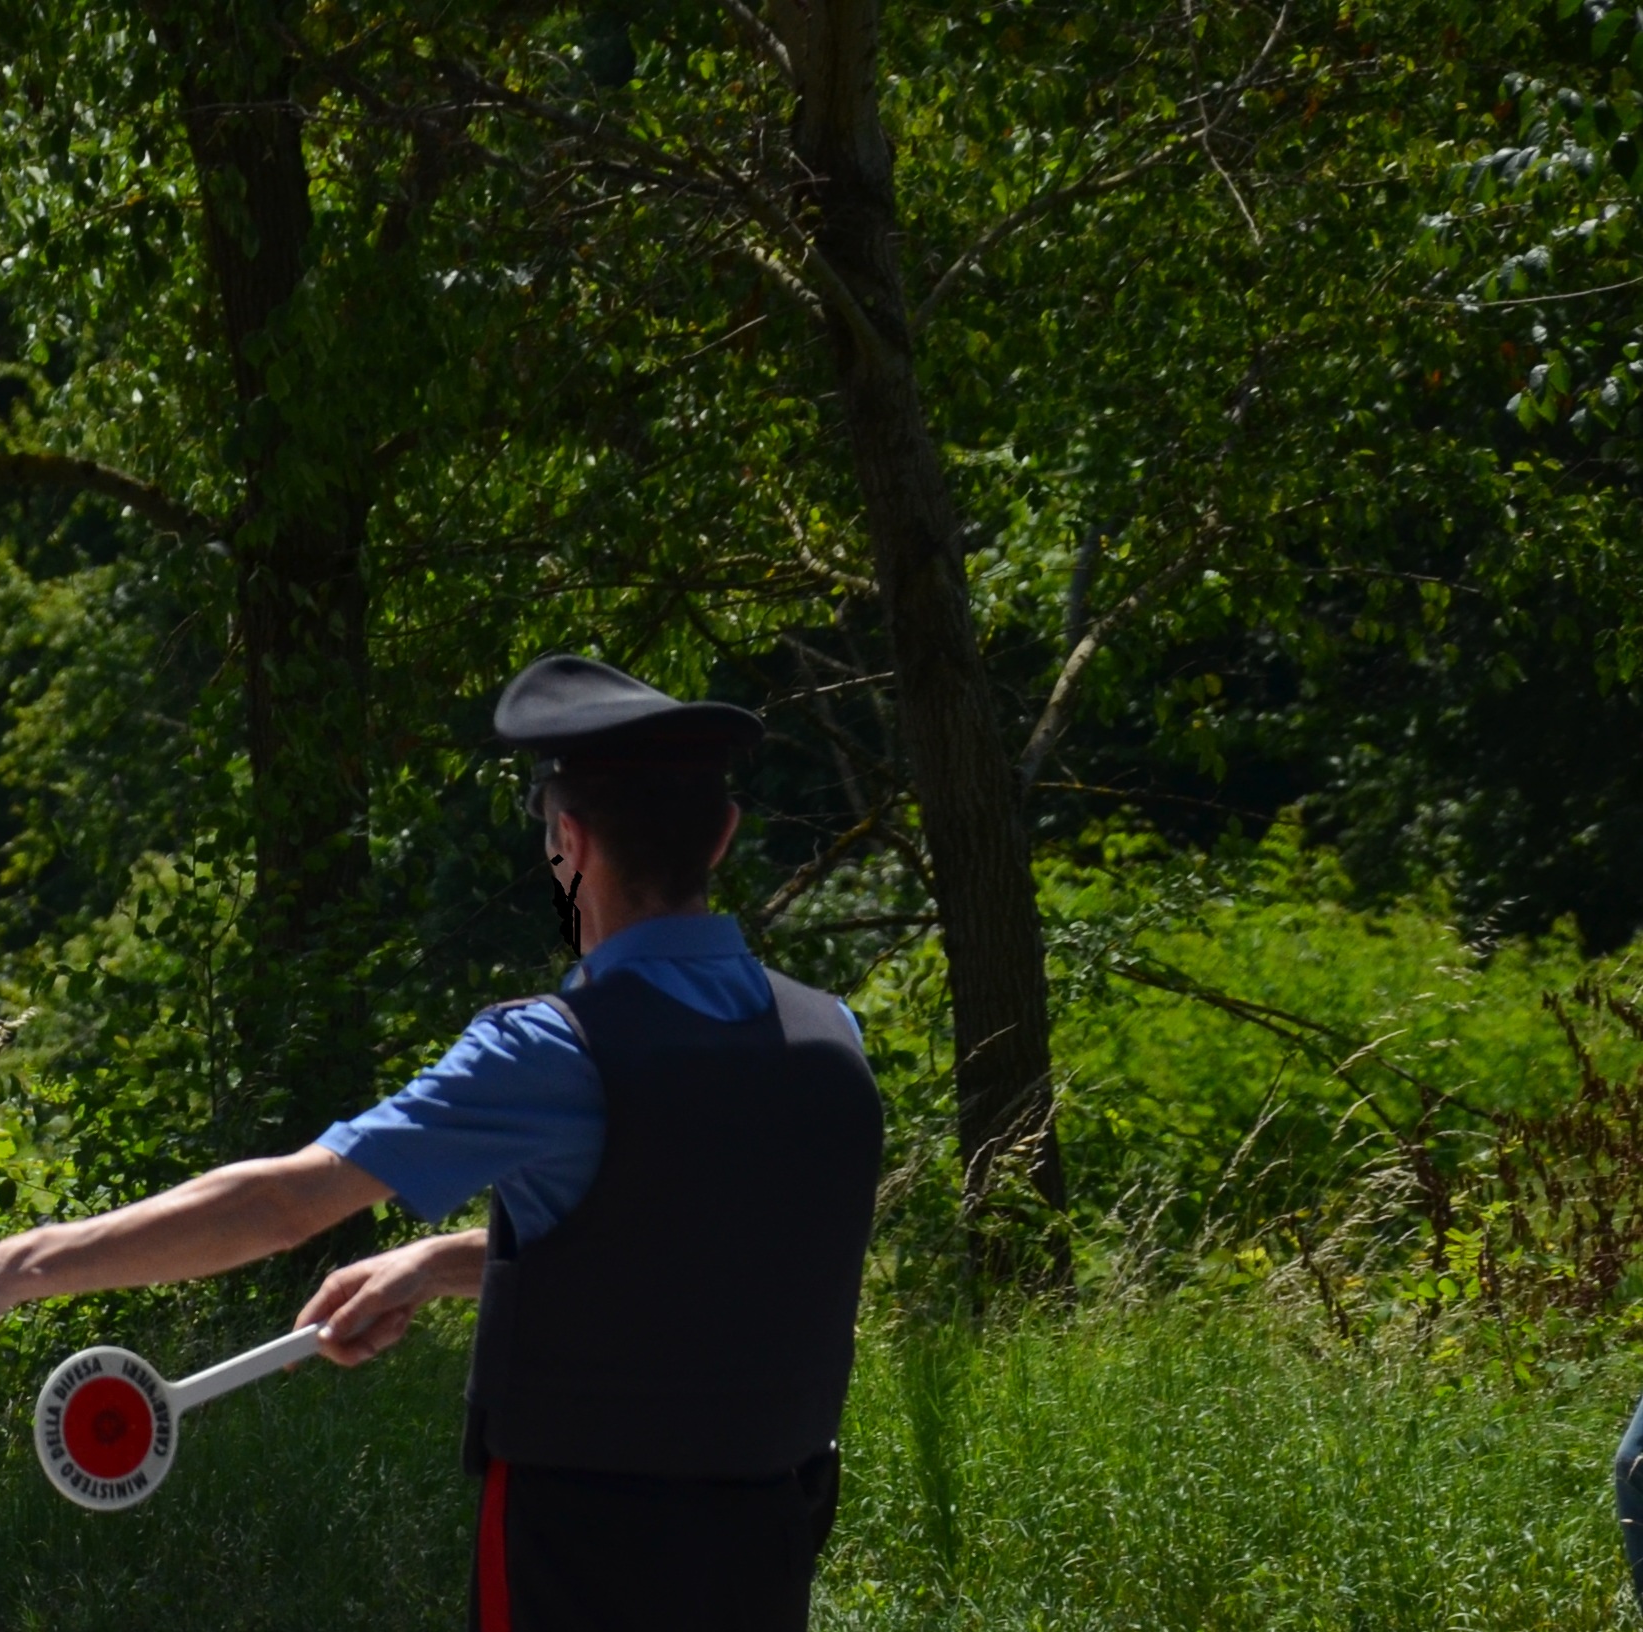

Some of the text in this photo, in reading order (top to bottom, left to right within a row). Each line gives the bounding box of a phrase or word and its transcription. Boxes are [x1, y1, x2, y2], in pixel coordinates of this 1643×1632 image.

[45, 1357, 148, 1499] MINISTERO DELLA DIFESA
